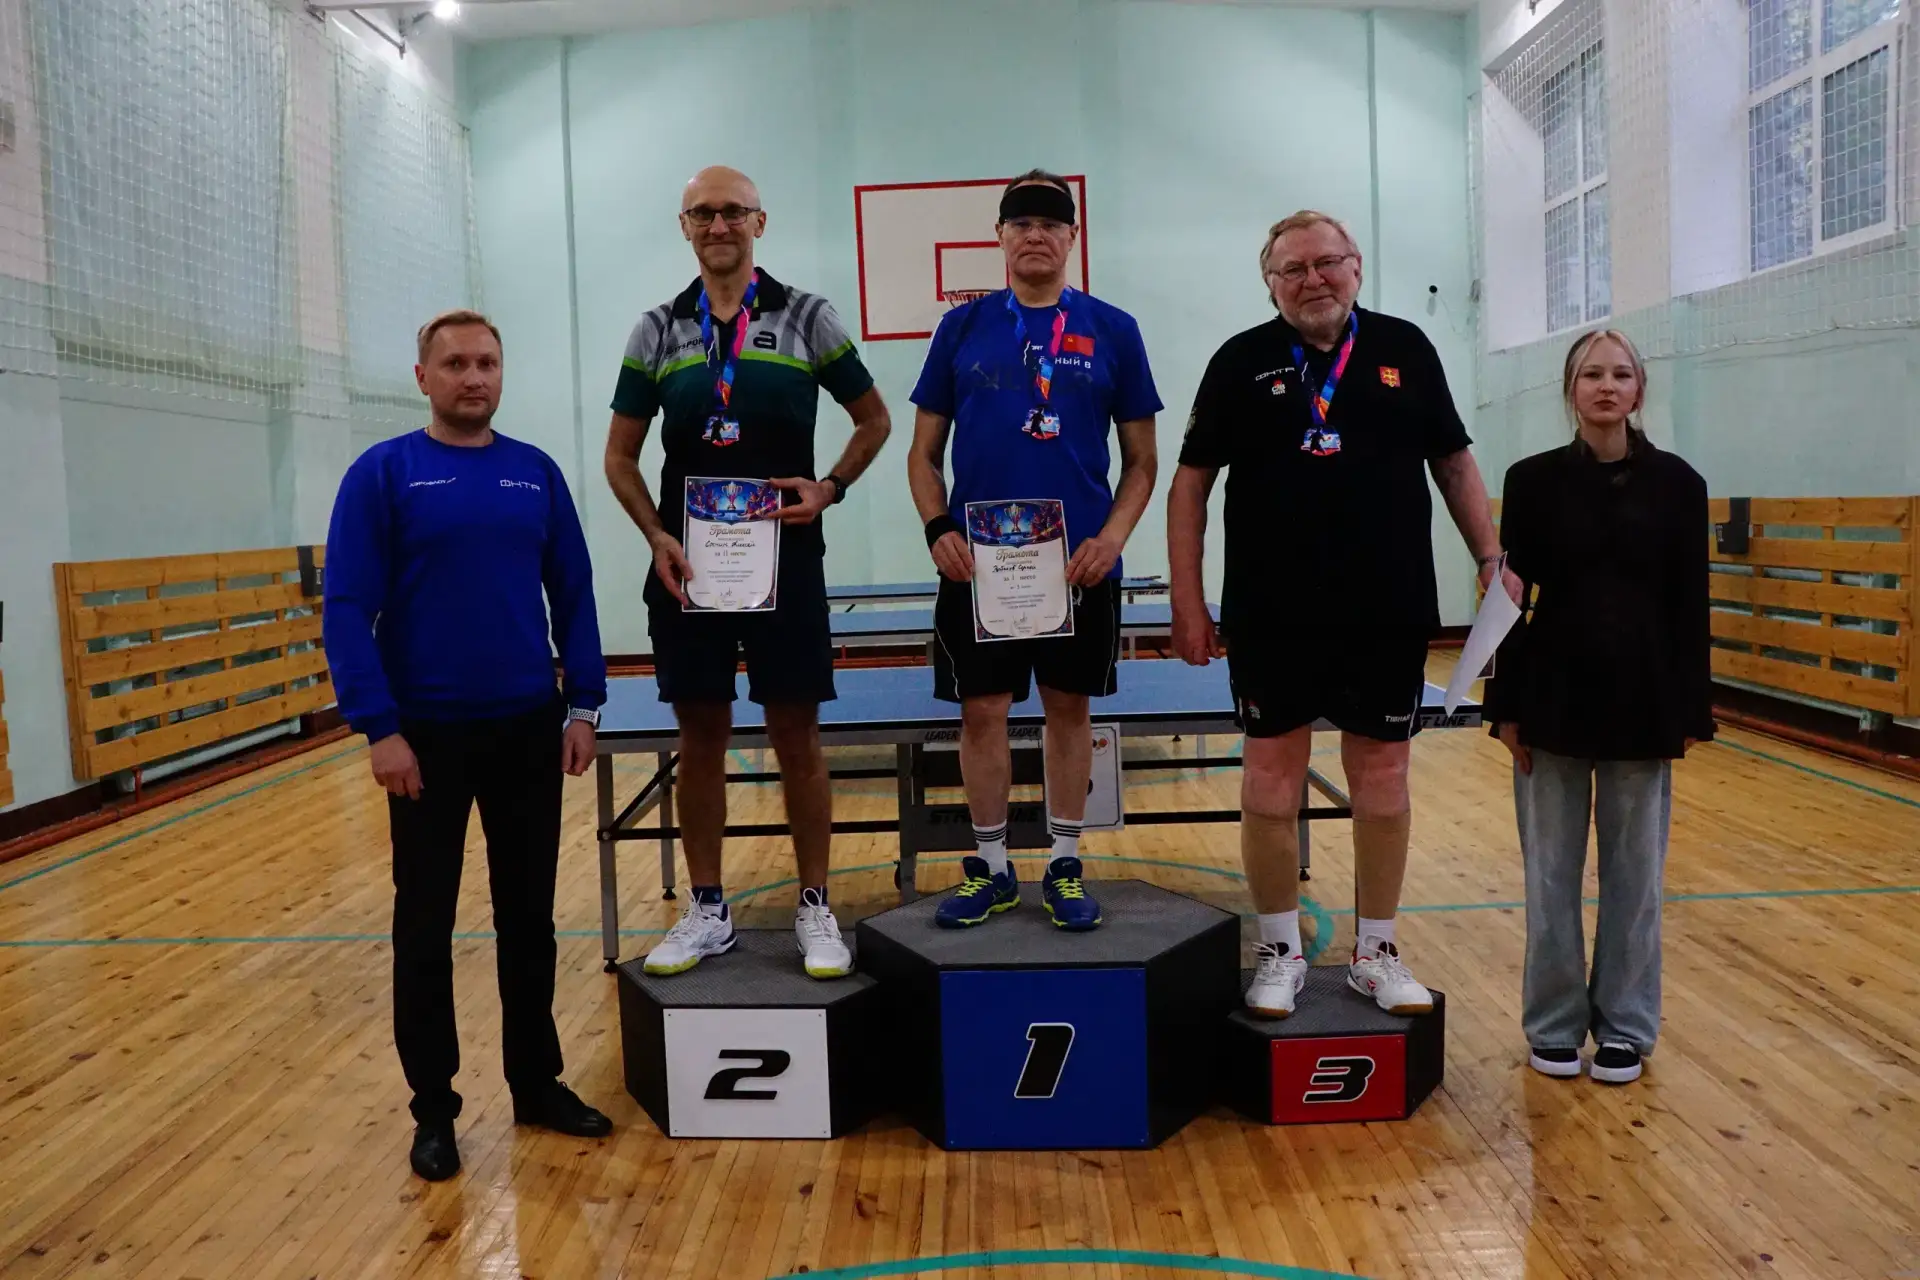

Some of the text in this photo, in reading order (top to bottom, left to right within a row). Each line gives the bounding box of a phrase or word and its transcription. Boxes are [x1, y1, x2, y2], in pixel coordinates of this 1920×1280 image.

[709, 525, 751, 537] Грамота
[996, 549, 1039, 562] Грамота
[1434, 716, 1468, 726] LINE
[924, 730, 959, 741] LEADER
[1013, 1022, 1075, 1099] 1
[703, 1049, 791, 1100] 2
[1302, 1055, 1376, 1103] 3
